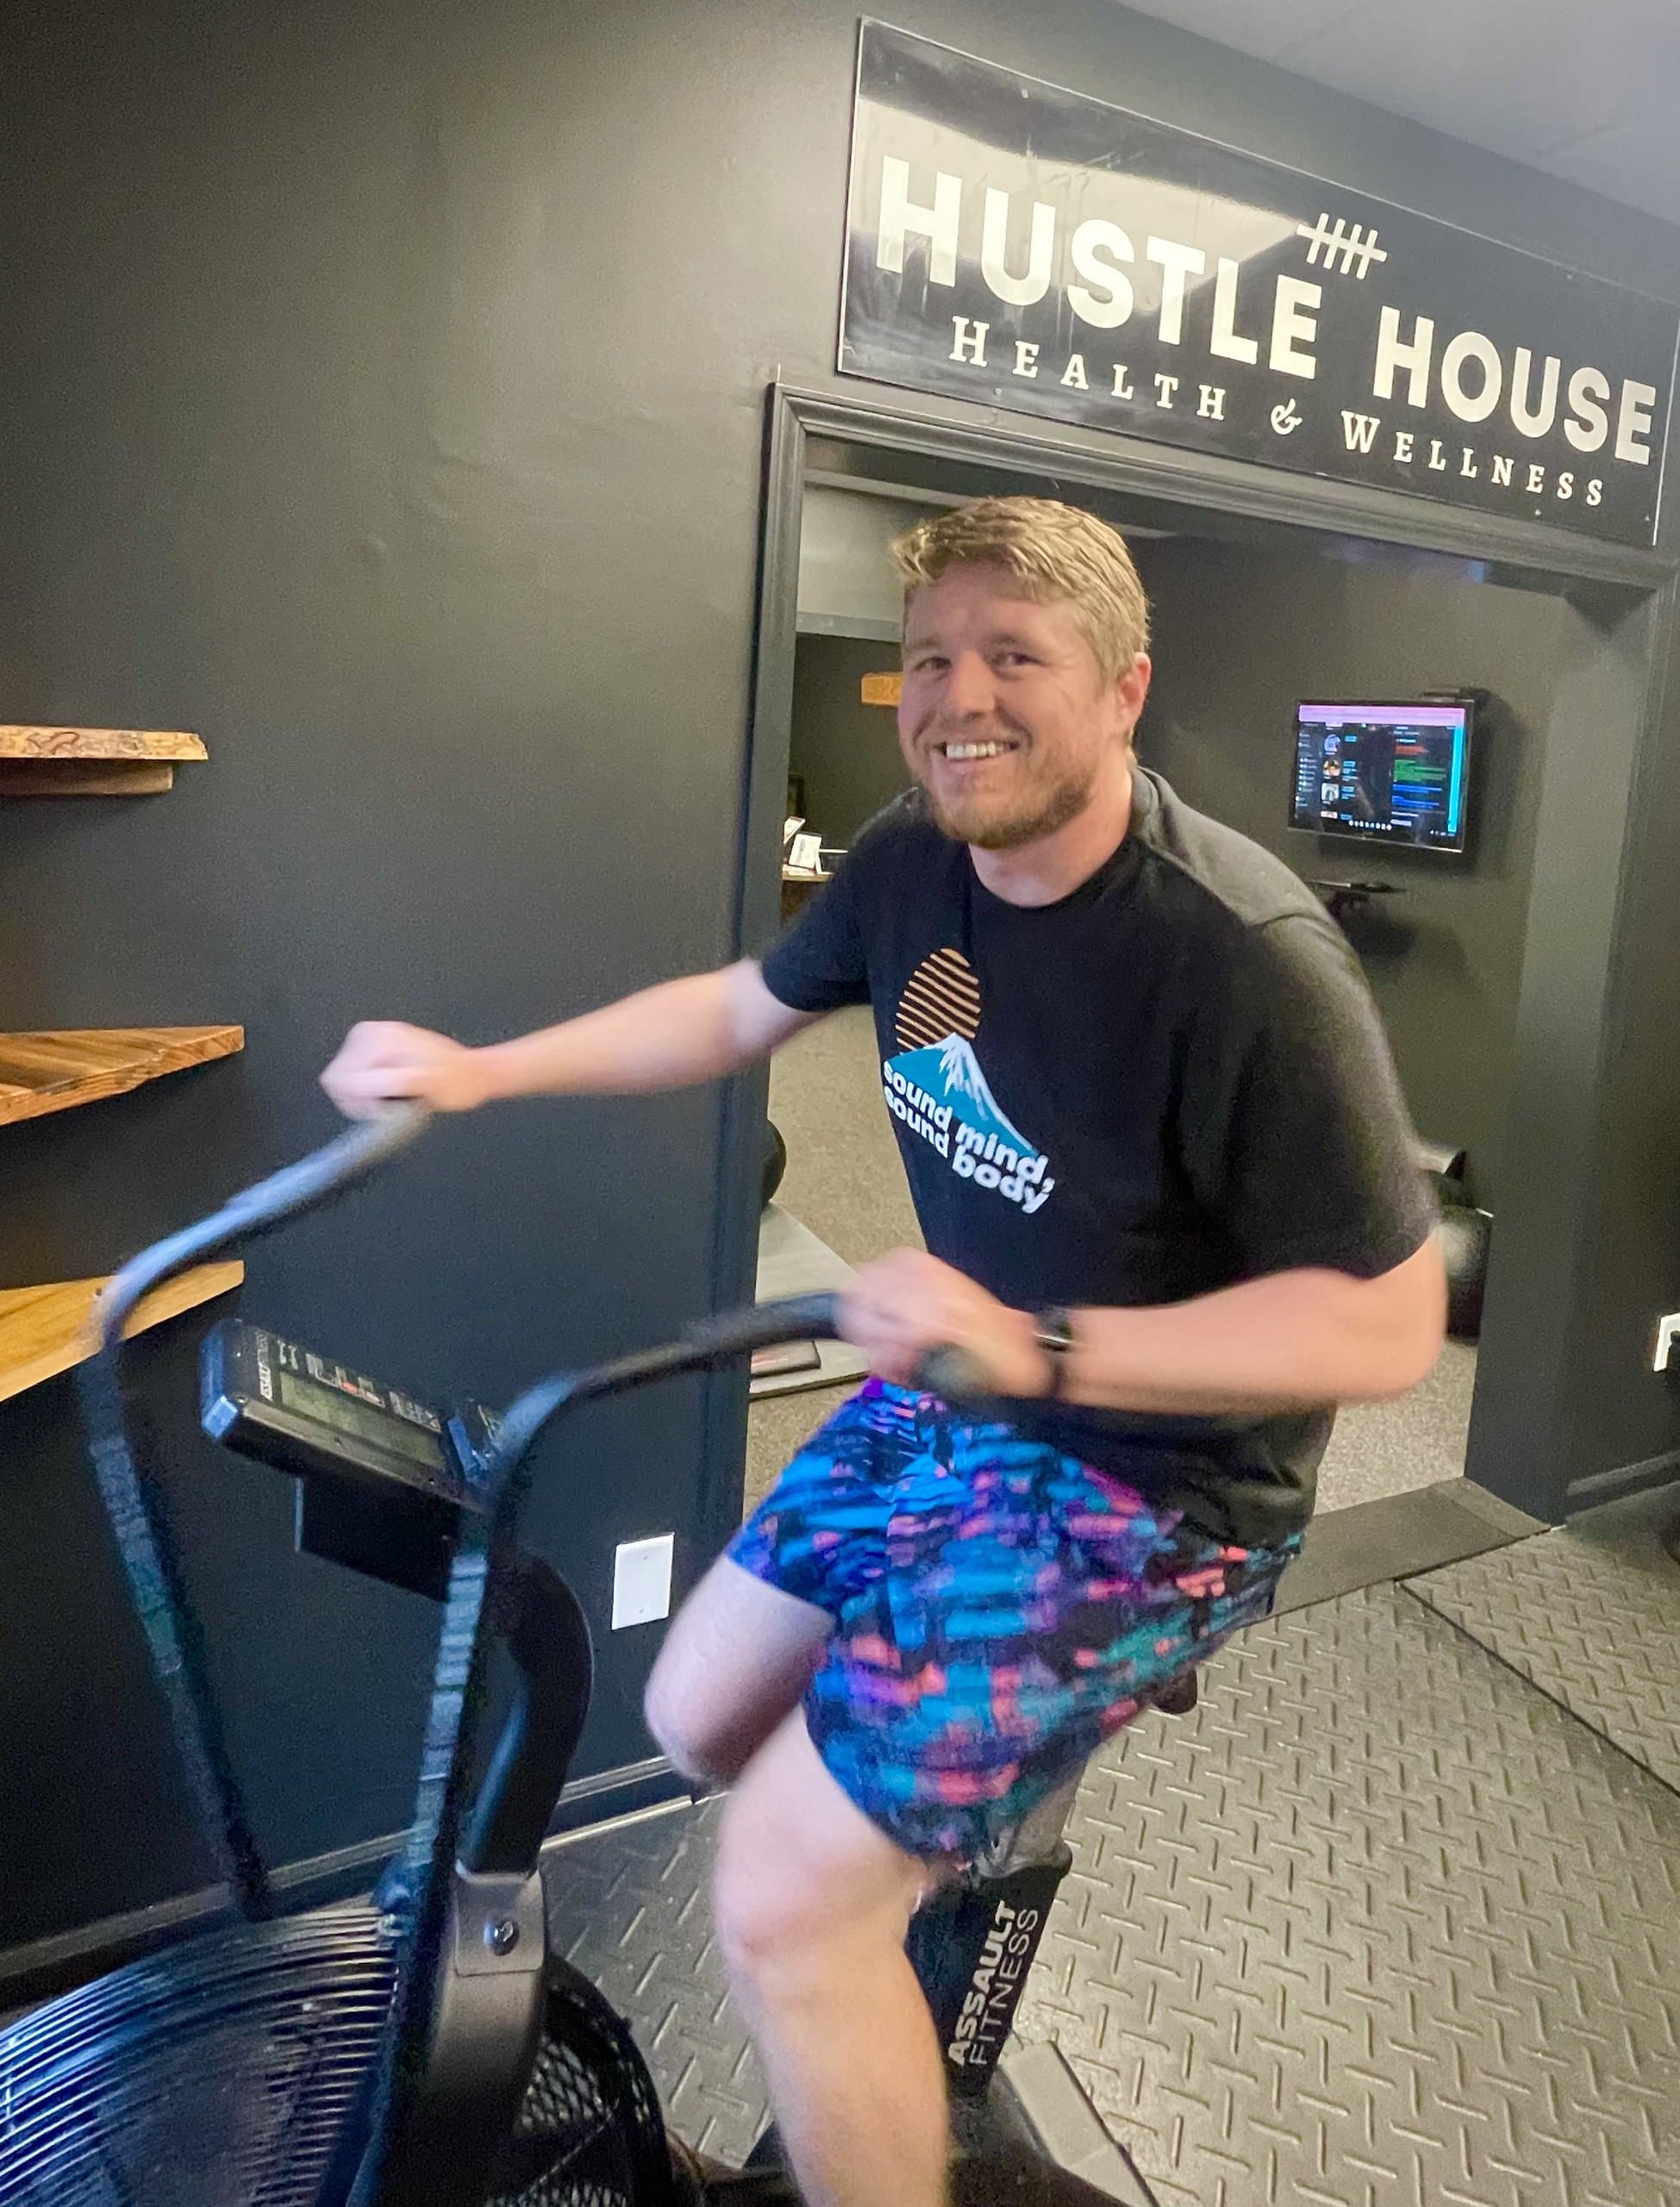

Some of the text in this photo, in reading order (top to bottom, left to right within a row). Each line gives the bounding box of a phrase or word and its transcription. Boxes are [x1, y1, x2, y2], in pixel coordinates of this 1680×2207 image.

[876, 158, 1658, 466] HUSTLE HOUSE
[949, 316, 1605, 506] HEALTH & WELLNESS
[884, 1060, 952, 1131] sound
[884, 1085, 1051, 1214] sound body
[948, 1900, 1016, 2066] ASSAULT
[970, 1909, 1039, 2065] FITNESS
